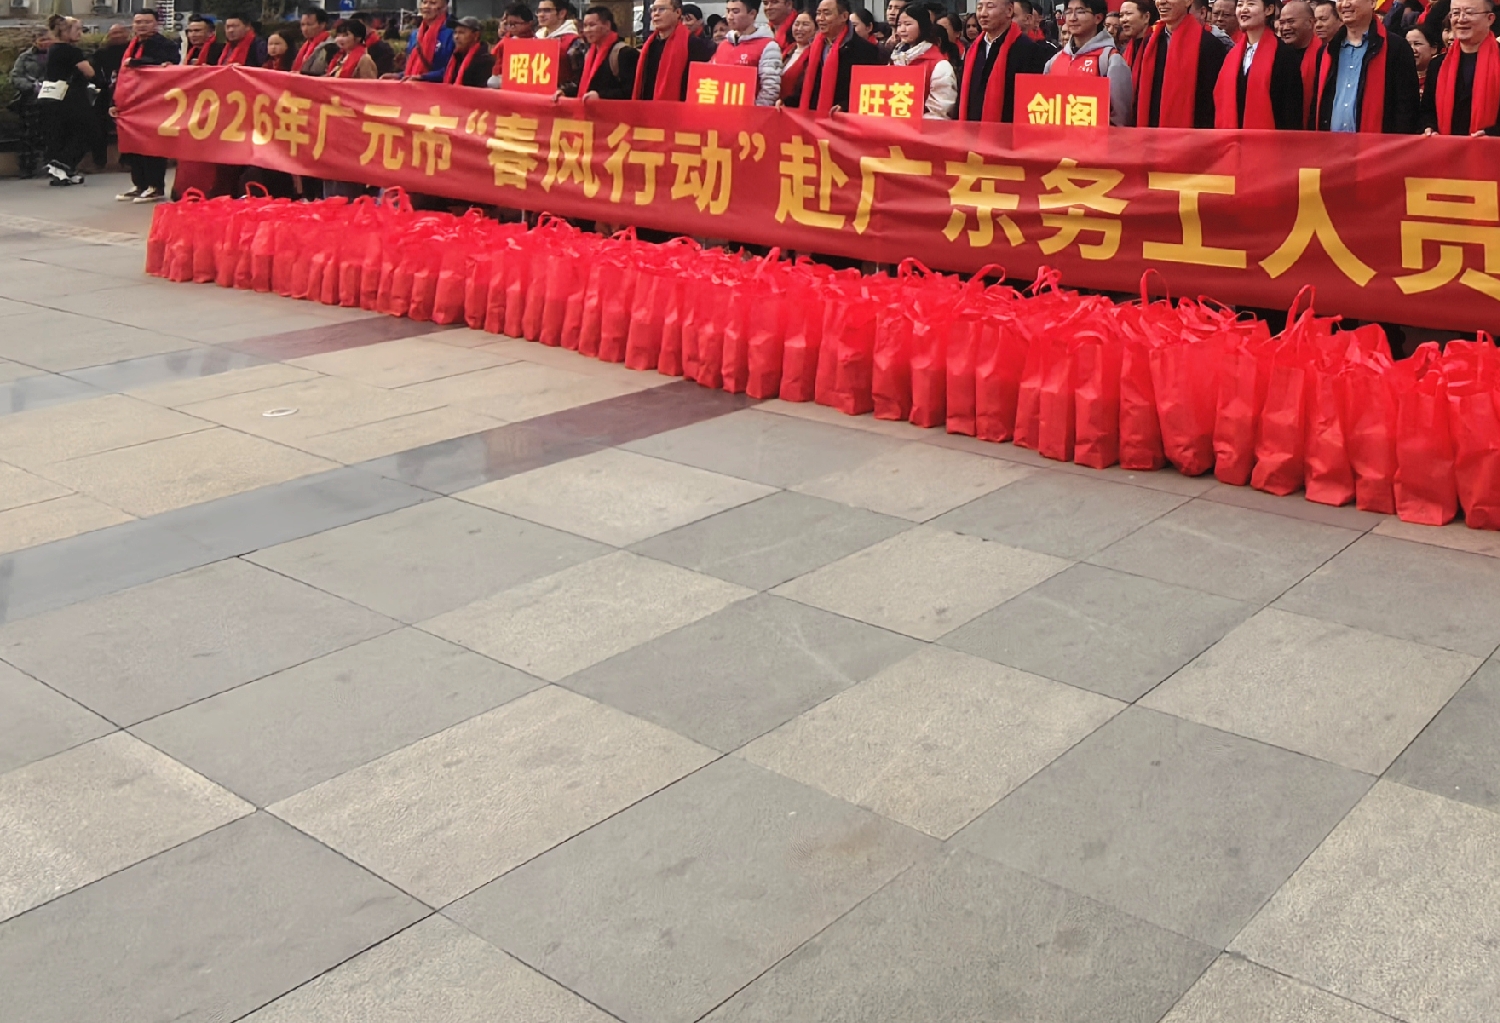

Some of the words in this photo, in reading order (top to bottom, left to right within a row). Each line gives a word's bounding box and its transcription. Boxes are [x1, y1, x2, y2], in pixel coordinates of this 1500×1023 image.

[509, 52, 551, 85] 昭化
[695, 77, 746, 106] 青川
[858, 82, 914, 118] 旺苍
[1027, 92, 1098, 126] 剑阁
